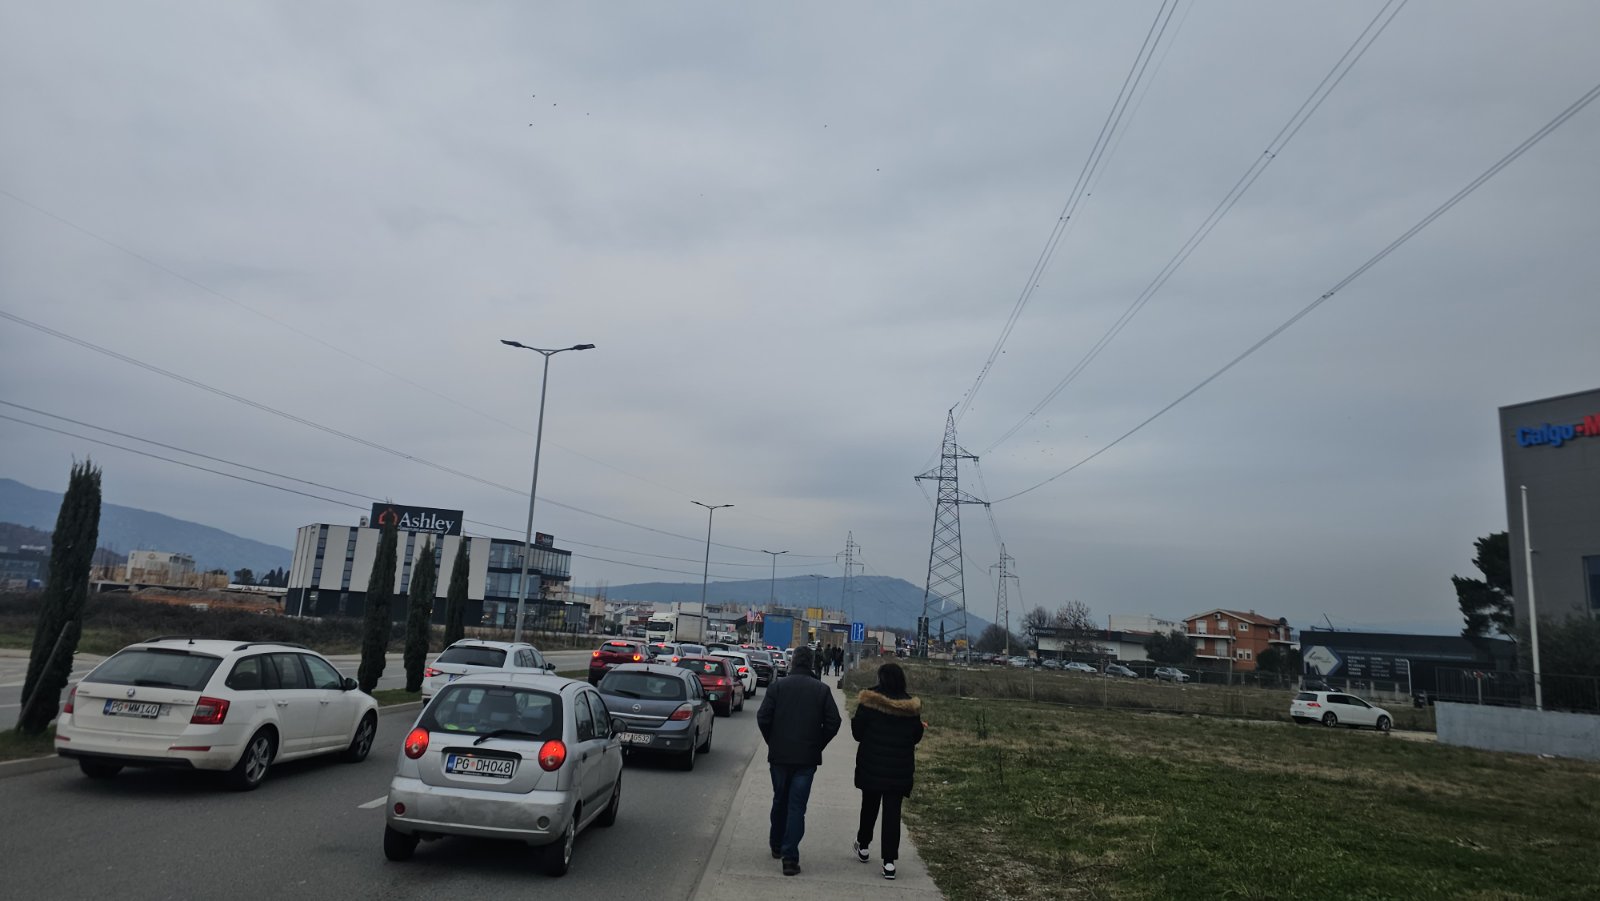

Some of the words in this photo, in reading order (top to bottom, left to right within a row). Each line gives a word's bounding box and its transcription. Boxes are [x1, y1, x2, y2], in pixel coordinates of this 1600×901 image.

[399, 511, 454, 534] Ashley
[112, 702, 123, 712] PG
[455, 758, 470, 769] PG
[476, 760, 511, 773] DH048
